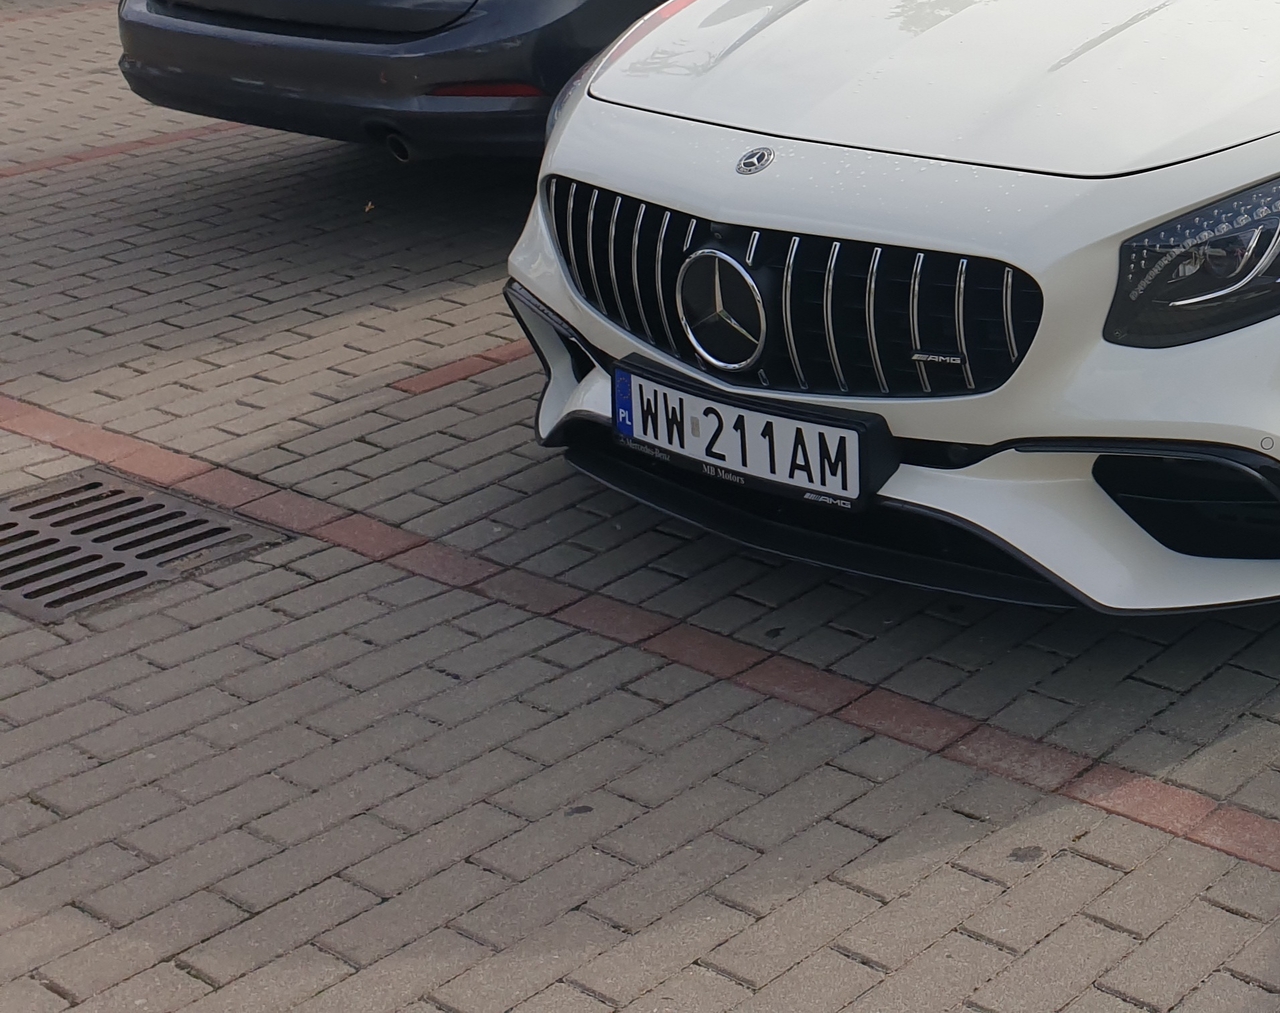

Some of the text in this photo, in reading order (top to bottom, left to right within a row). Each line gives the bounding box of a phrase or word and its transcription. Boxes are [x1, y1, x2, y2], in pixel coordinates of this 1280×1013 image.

[619, 409, 631, 426] PL
[638, 383, 848, 491] WW 211AM
[702, 463, 745, 484] MB Motors
